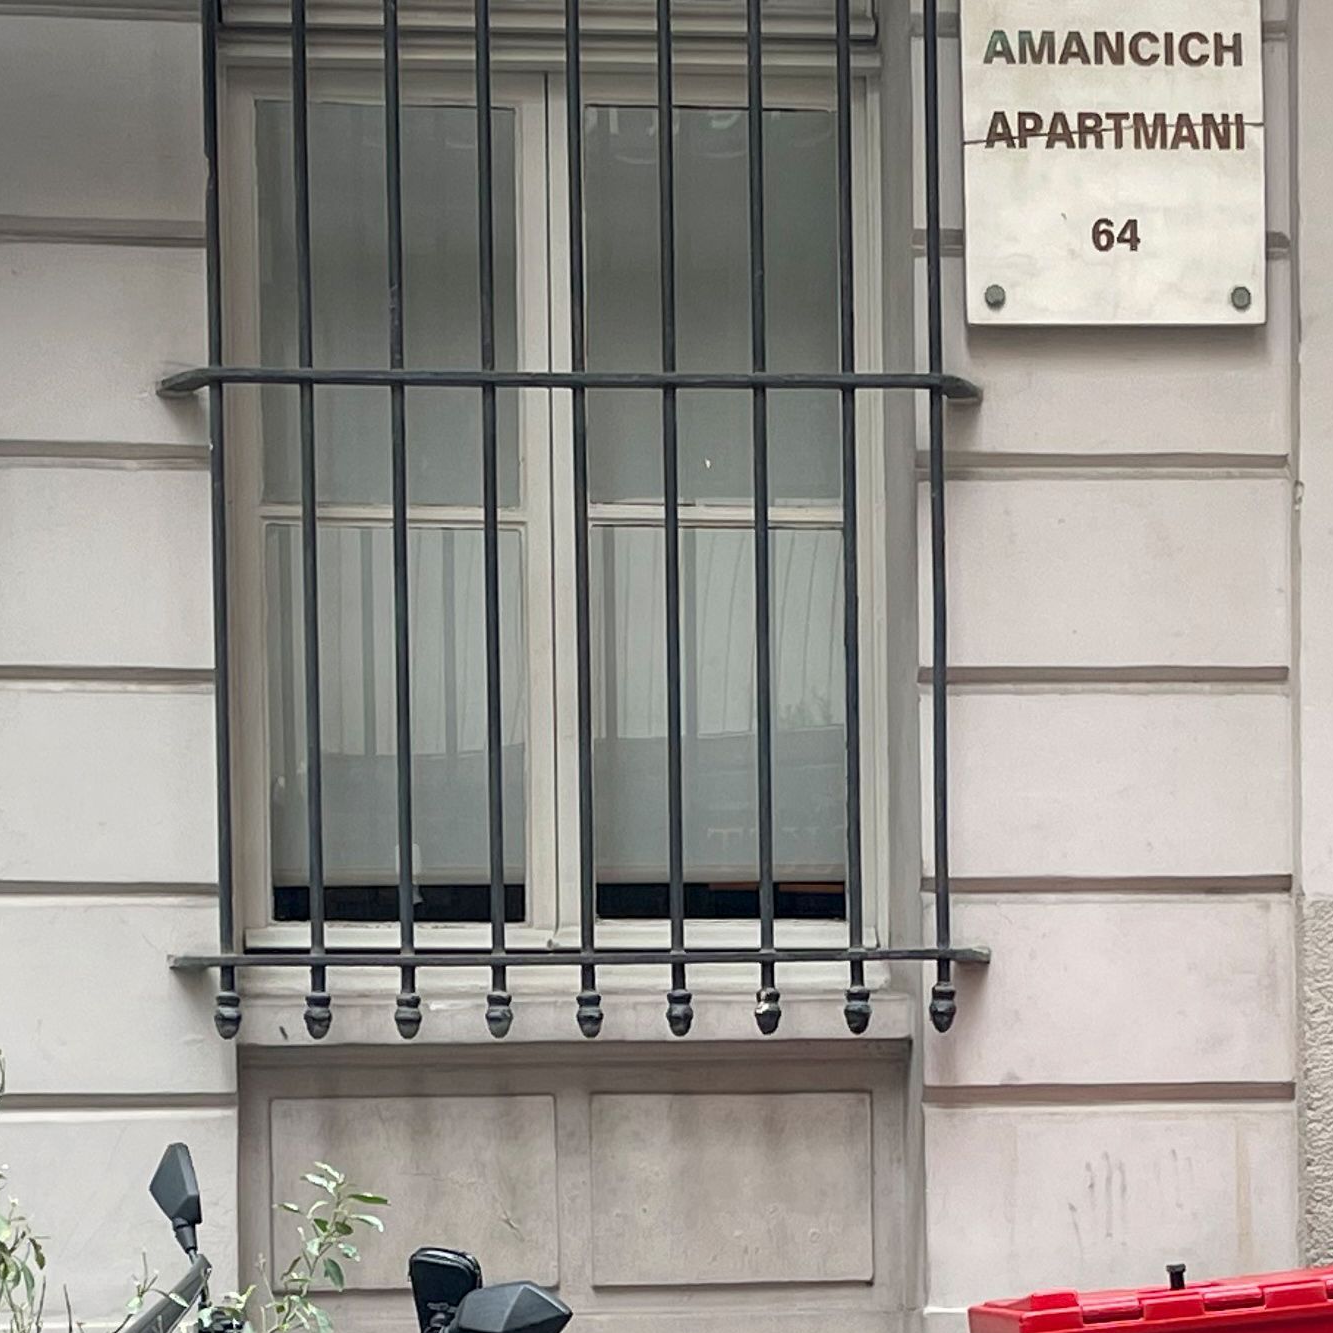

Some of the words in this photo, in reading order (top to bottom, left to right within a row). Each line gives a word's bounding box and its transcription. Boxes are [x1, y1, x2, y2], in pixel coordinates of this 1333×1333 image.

[983, 29, 1244, 67] AMANCICH
[984, 110, 1245, 151] APARTMANI
[1090, 217, 1141, 253] 64
